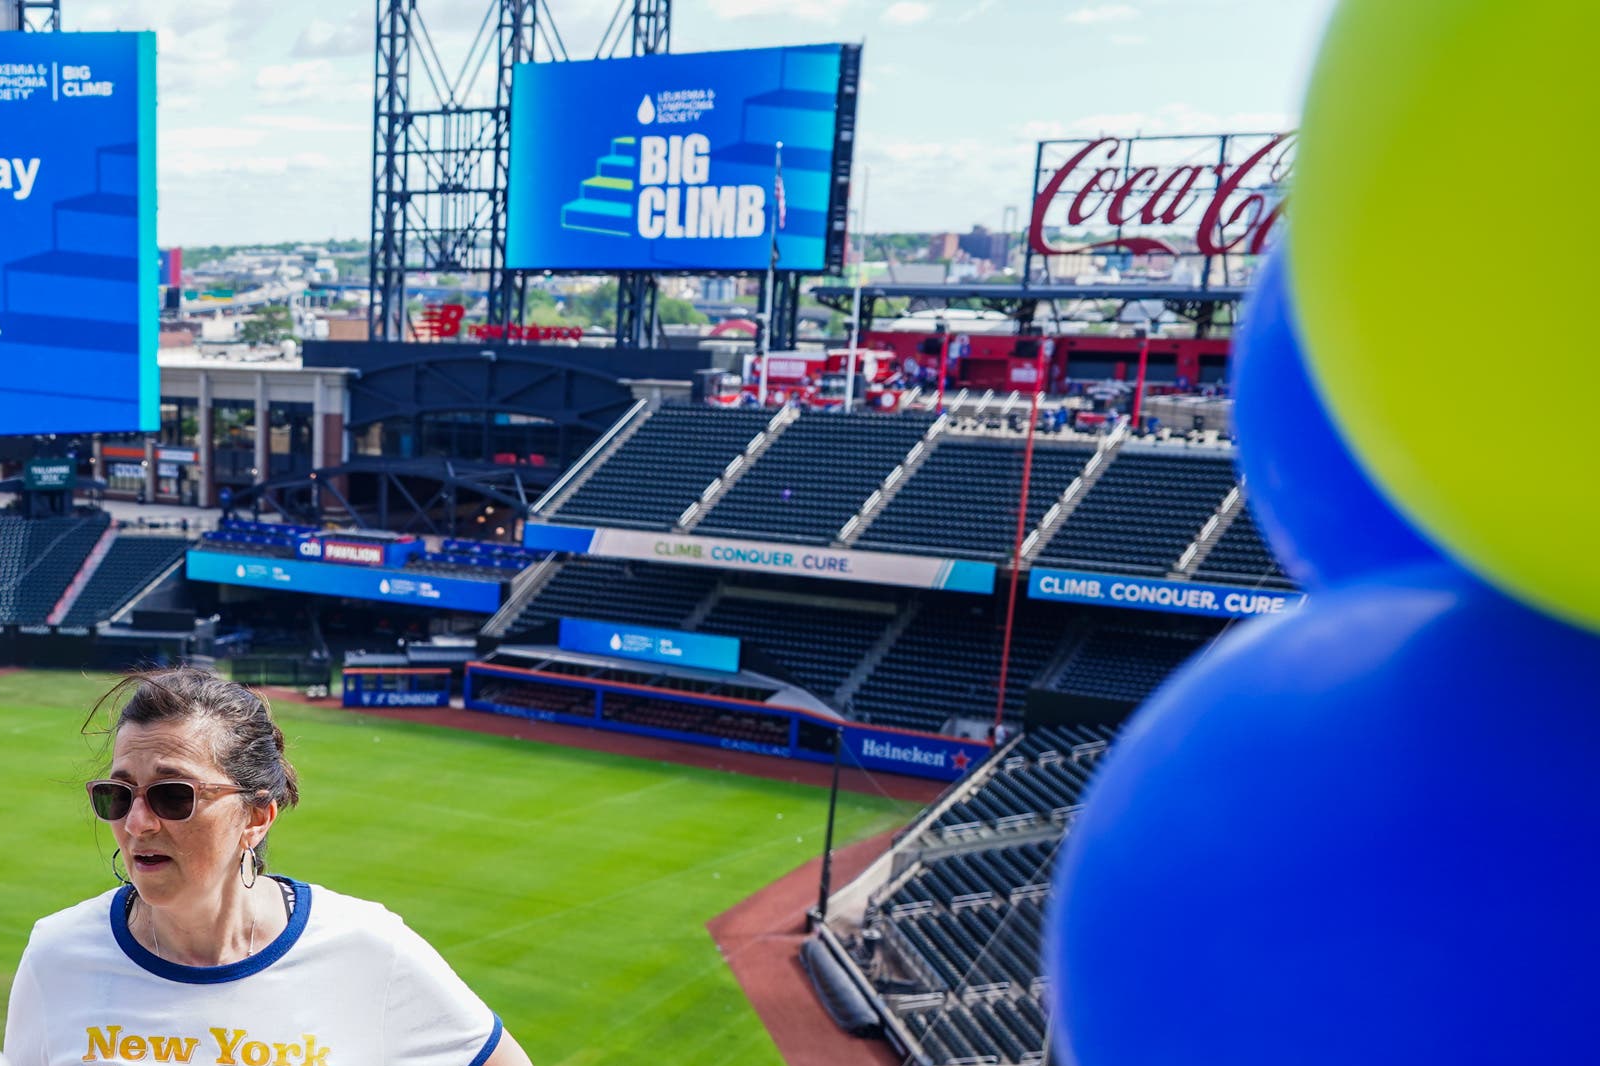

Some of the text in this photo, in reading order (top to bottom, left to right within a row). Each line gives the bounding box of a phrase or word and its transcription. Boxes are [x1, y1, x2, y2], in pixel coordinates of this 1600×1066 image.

[37, 64, 48, 76] &
[62, 65, 91, 80] BIG
[62, 81, 113, 97] CLIMB
[639, 133, 711, 185] BIG
[637, 185, 766, 239] CLIMB
[655, 541, 853, 574] CLIMB. CONQUER. CURE.
[1040, 576, 1288, 616] CLIMB. CONQUER. CURE.
[862, 738, 945, 767] Heineken
[81, 1025, 201, 1064] New
